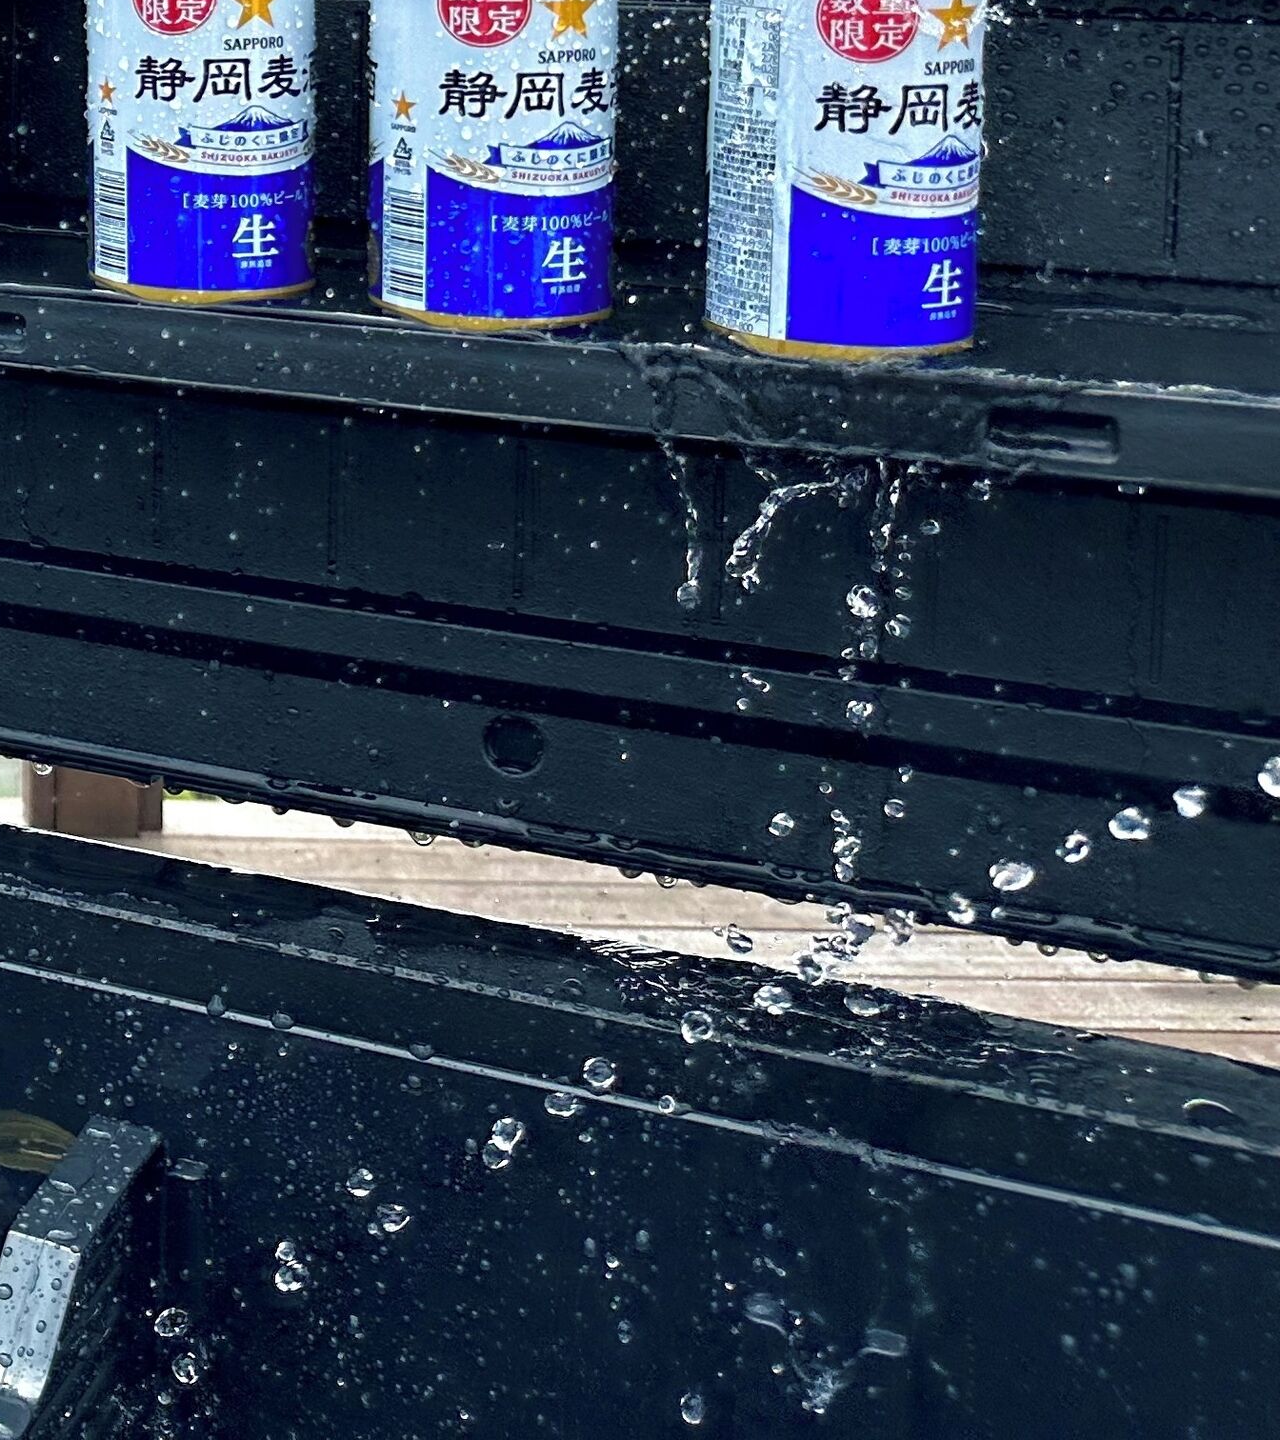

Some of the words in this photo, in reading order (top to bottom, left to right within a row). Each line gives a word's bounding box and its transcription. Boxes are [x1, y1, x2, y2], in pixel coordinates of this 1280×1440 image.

[448, 5, 522, 36] 限定
[223, 36, 284, 51] SAPPORO
[829, 19, 912, 52] 限定
[538, 48, 596, 64] SAPPORO
[924, 58, 975, 76] SAPPORO
[200, 151, 258, 162] SHIZUOKA
[511, 171, 569, 182] SHIZUOKA
[890, 191, 950, 202] SHIZUOKA
[231, 213, 279, 258] 生
[541, 237, 587, 283] 生
[921, 259, 962, 309] 生
